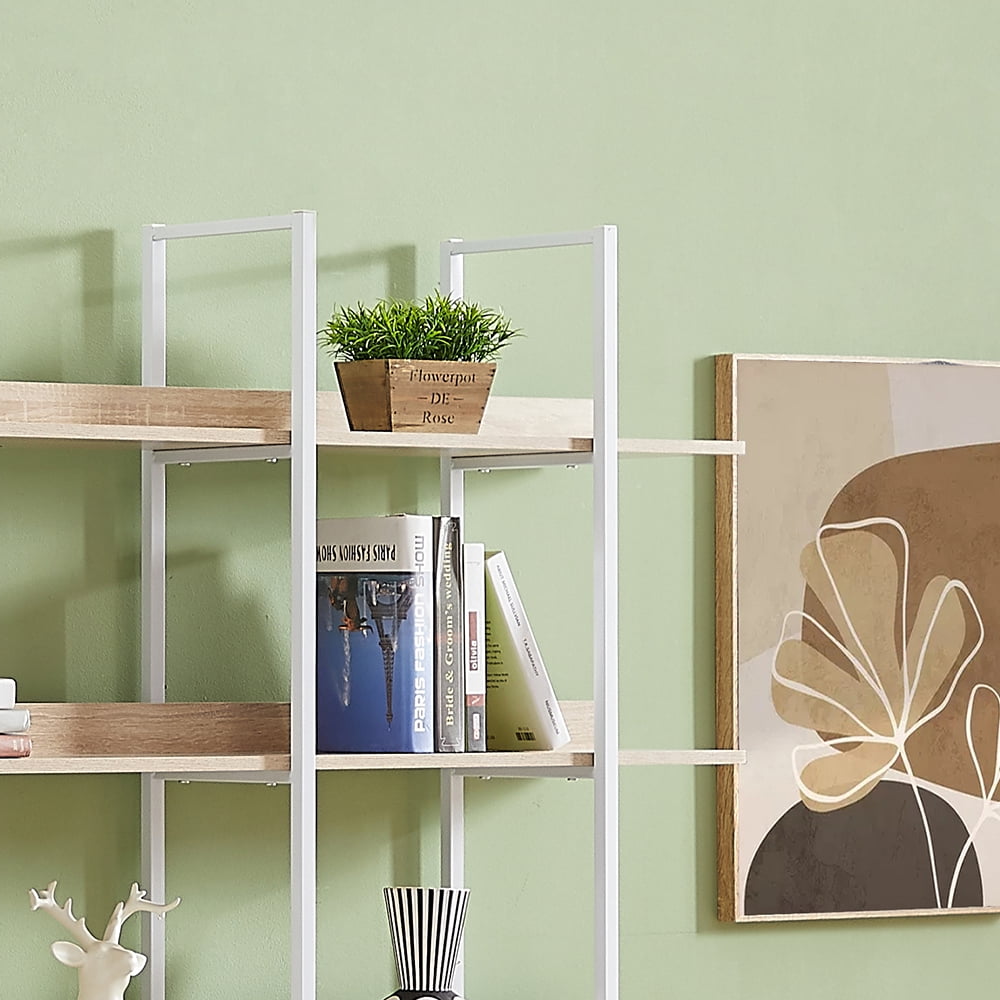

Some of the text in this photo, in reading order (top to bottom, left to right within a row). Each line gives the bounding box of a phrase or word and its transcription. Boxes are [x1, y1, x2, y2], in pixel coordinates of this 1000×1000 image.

[410, 369, 477, 387] Flowerpot
[422, 411, 455, 424] Rose
[372, 544, 396, 561] PARIS
[443, 542, 453, 599] wedding
[469, 640, 478, 670] olivia
[445, 670, 454, 683] &
[445, 687, 454, 726] Bride
